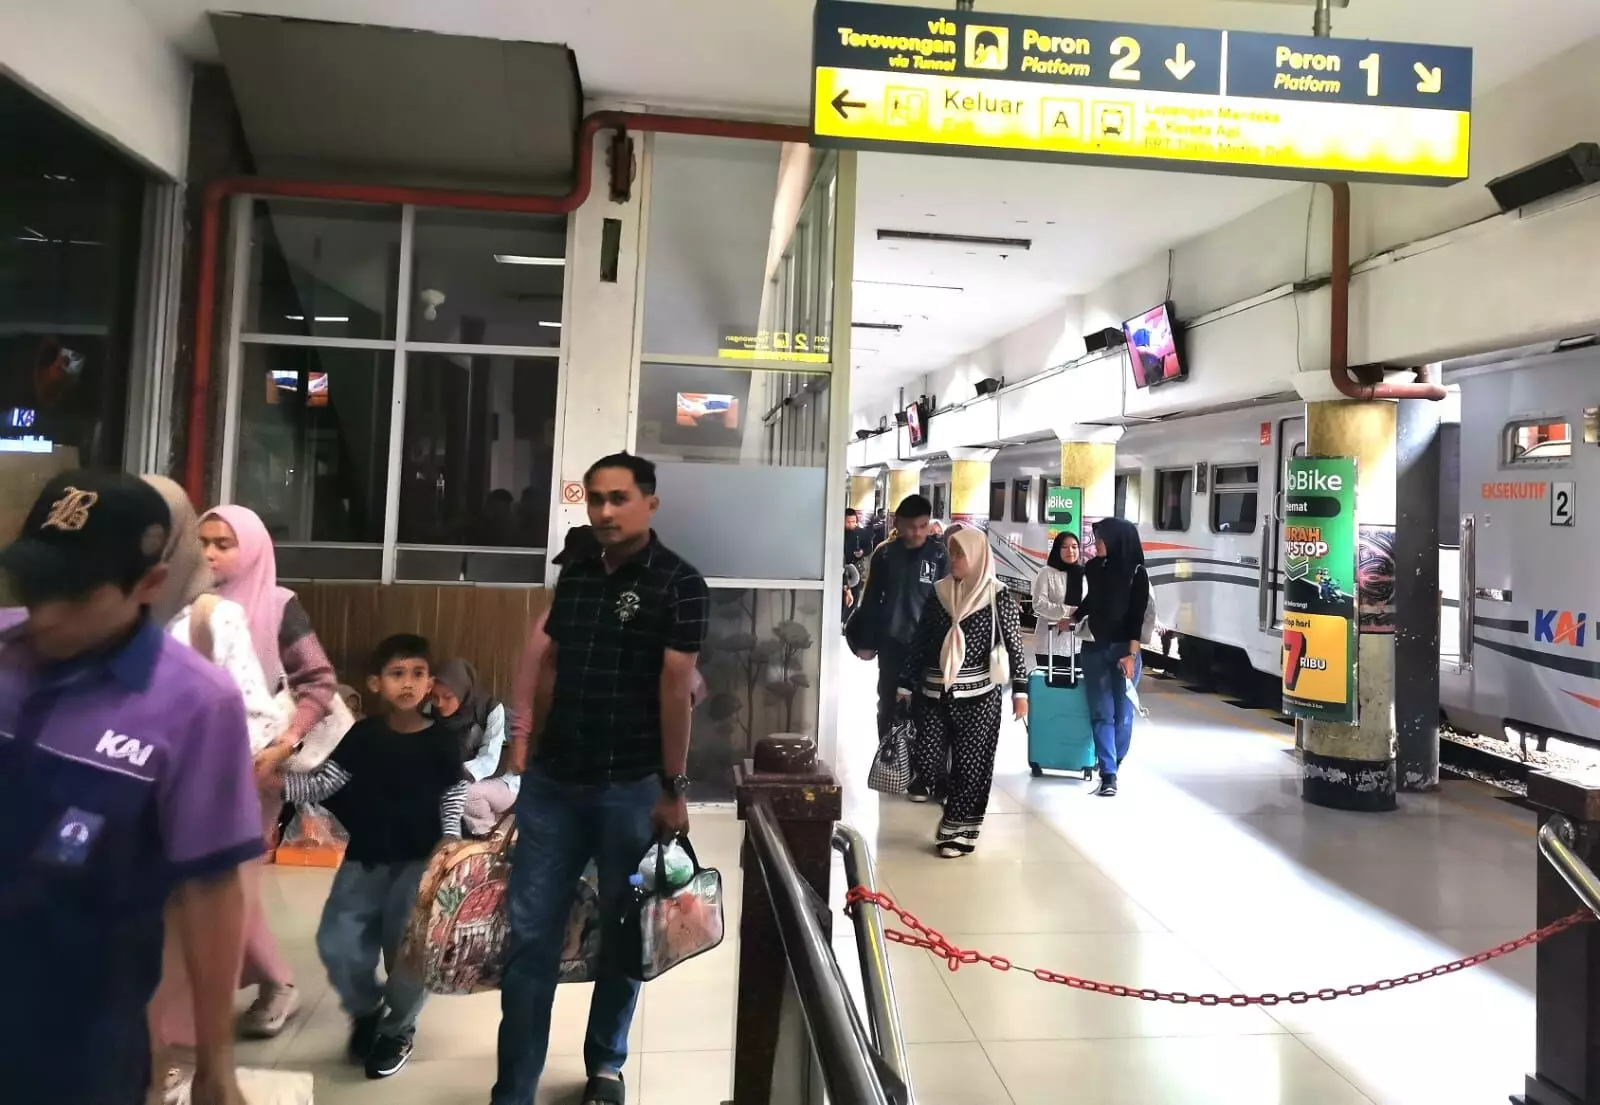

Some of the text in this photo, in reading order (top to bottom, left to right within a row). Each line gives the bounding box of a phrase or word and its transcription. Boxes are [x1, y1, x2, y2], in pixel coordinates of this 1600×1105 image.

[928, 17, 957, 36] via
[838, 26, 957, 56] Terowongan
[1023, 29, 1090, 55] Peron
[889, 53, 957, 72] via Tunnel
[1021, 56, 1091, 77] Platform
[1108, 36, 1141, 81] 2
[1275, 46, 1341, 72] Peron
[1274, 72, 1341, 94] Platform
[1358, 53, 1380, 97] 1
[944, 89, 1024, 115] Keluar
[1285, 468, 1342, 491] bBike
[1481, 482, 1547, 500] EKSEKUTIF
[1047, 495, 1073, 509] Bike
[1556, 490, 1569, 516] 2
[1534, 608, 1587, 648] KAI
[1283, 629, 1307, 691] 7
[1300, 656, 1327, 671] RIBU
[95, 729, 155, 767] KAI
